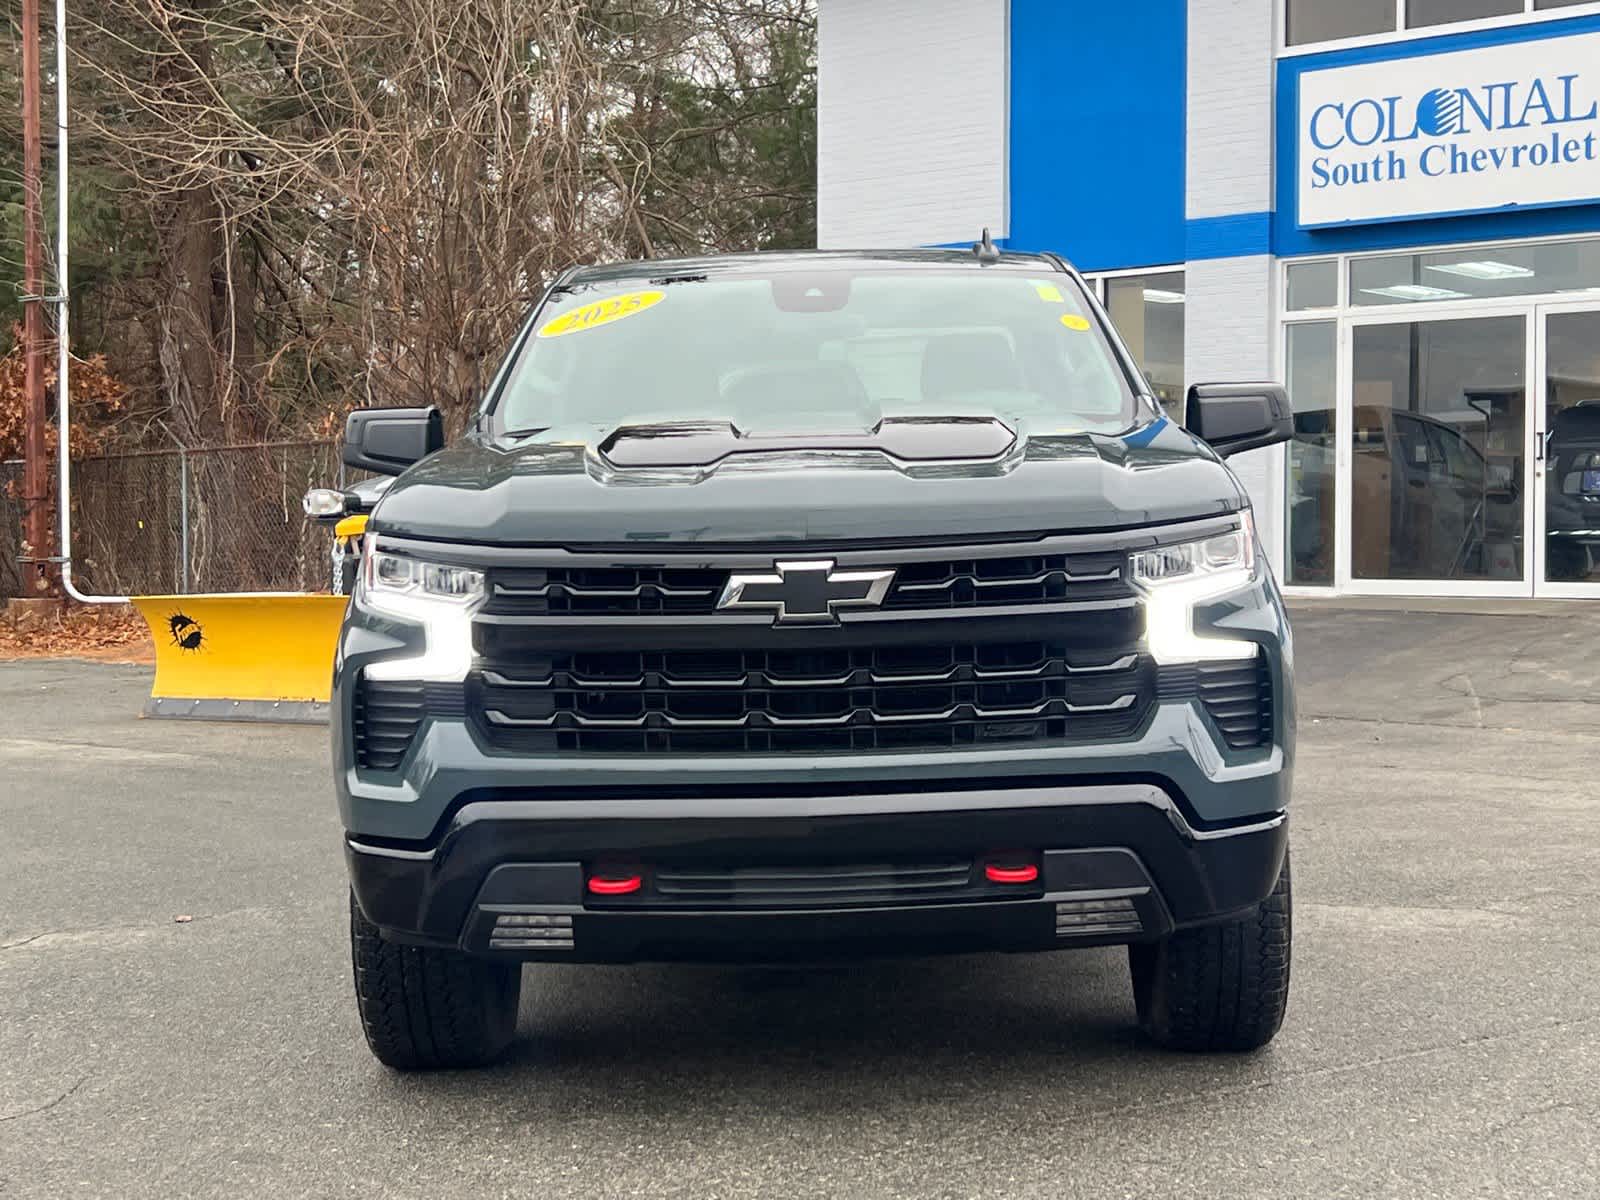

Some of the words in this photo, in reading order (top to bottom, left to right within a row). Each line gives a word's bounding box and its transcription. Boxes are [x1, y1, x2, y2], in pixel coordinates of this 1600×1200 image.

[1310, 74, 1597, 150] COLONIAL
[1311, 150, 1406, 189] South
[1419, 131, 1597, 177] Chevrolet
